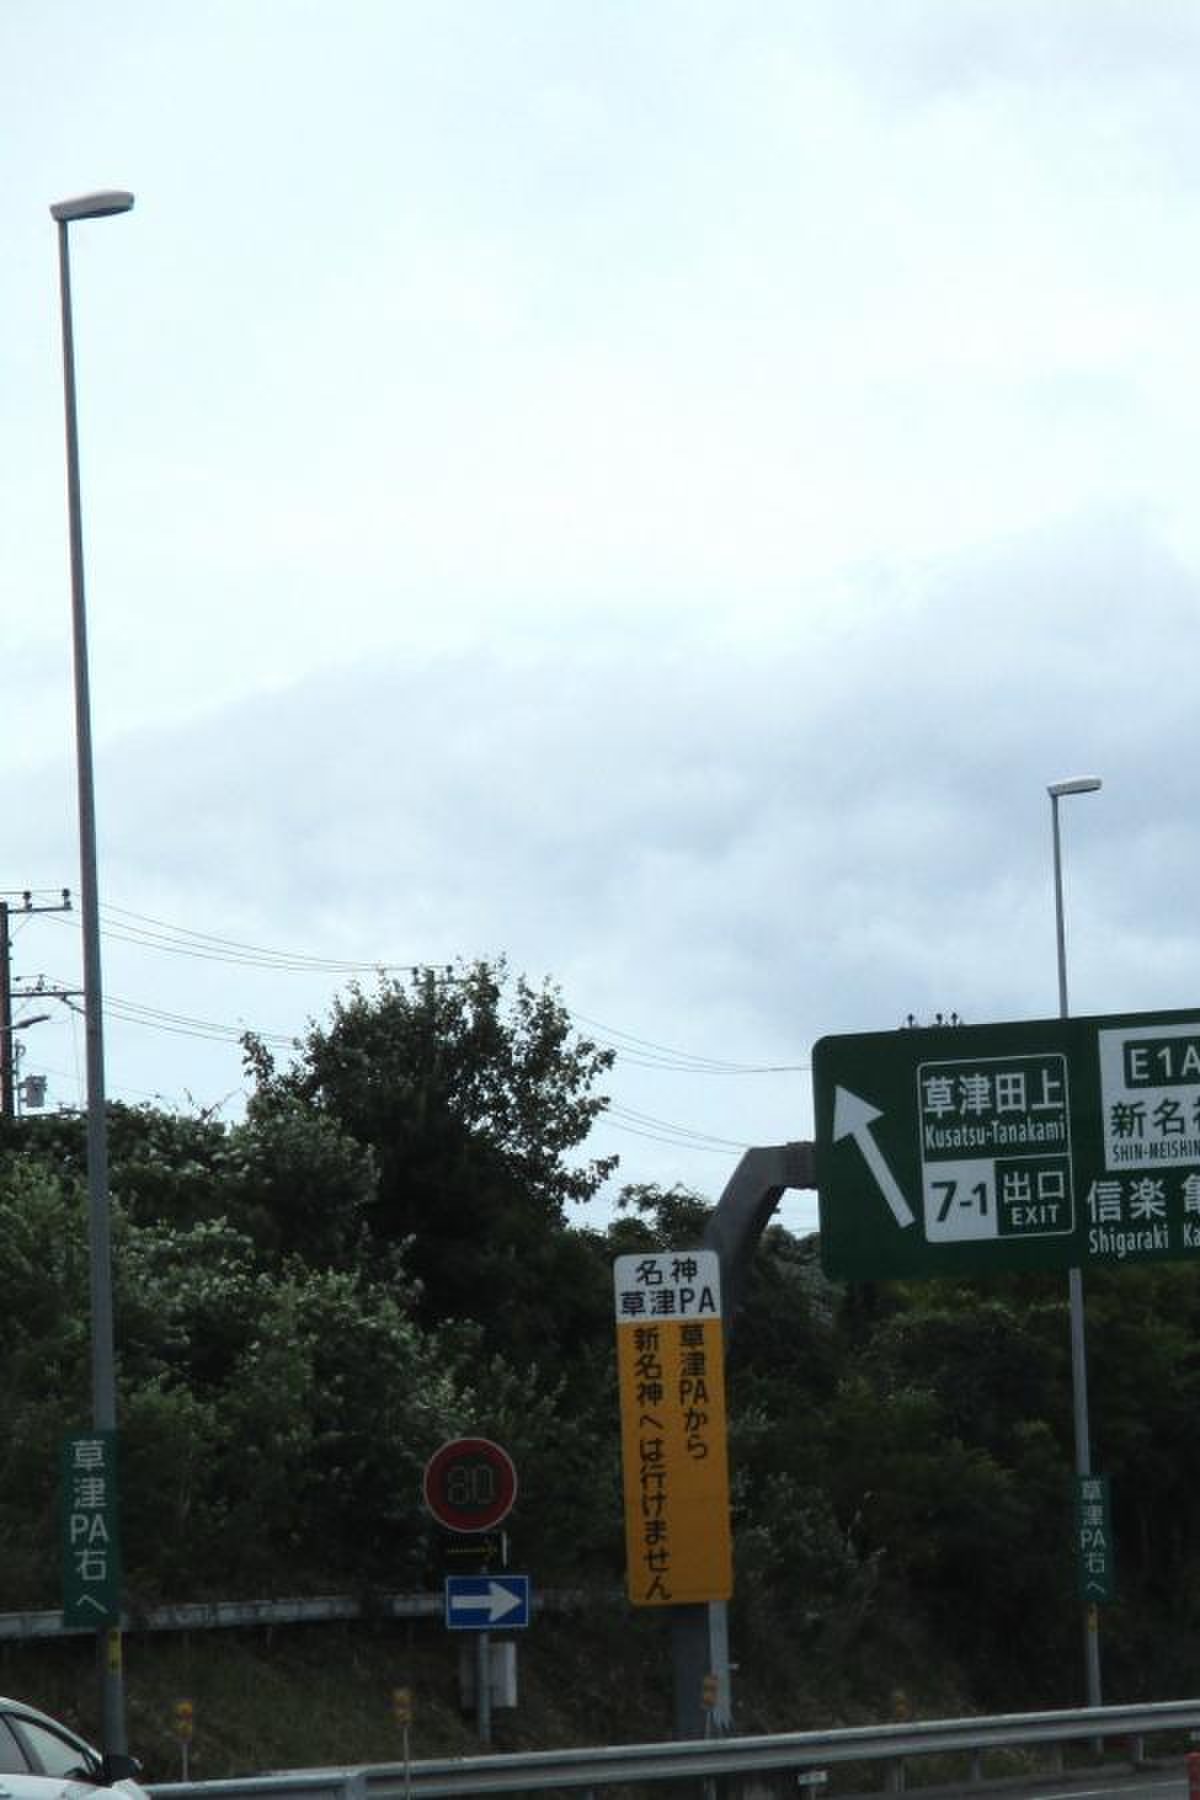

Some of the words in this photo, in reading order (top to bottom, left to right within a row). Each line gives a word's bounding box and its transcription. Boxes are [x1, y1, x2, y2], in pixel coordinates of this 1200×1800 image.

[922, 1068, 1064, 1118] 草津田上
[925, 1115, 1066, 1150] Kusatsu-Tanakami
[931, 1180, 988, 1222] 7-1
[1003, 1171, 1065, 1203] 出口
[1088, 1177, 1168, 1223] 信楽
[1011, 1205, 1061, 1225] EXIT
[1088, 1224, 1169, 1258] Shigaraki
[635, 1258, 698, 1286] 名神
[620, 1287, 716, 1316] 草津PA
